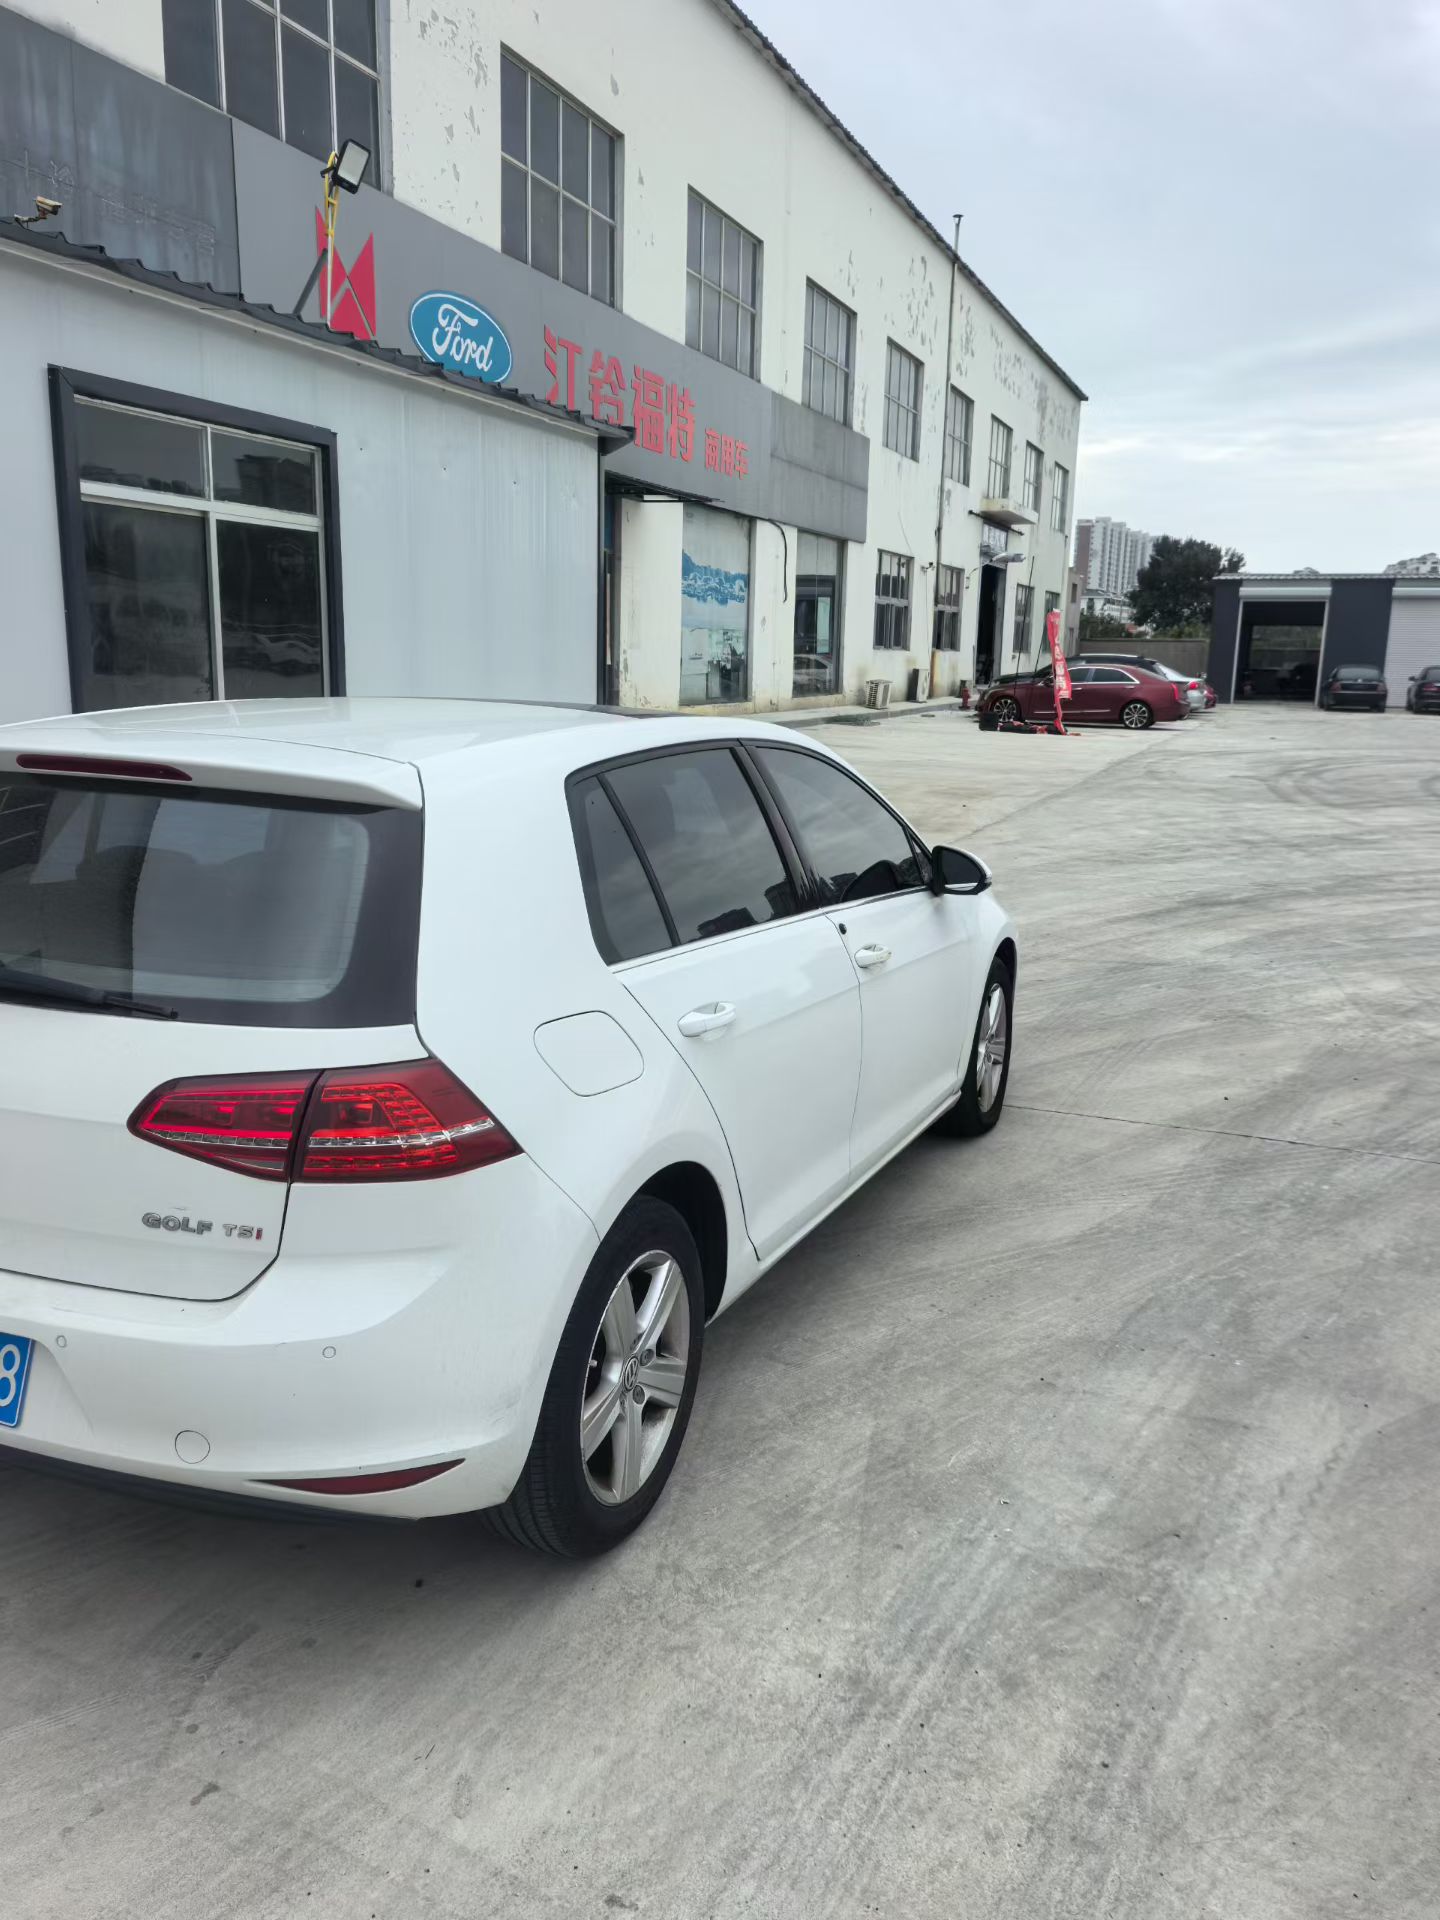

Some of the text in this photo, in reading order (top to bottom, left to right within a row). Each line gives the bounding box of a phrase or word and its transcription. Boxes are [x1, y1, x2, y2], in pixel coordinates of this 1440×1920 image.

[432, 303, 493, 372] Ford
[544, 324, 749, 480] 江铃福特 商用车
[142, 1212, 213, 1235] GOLF
[0, 1344, 20, 1407] 8
